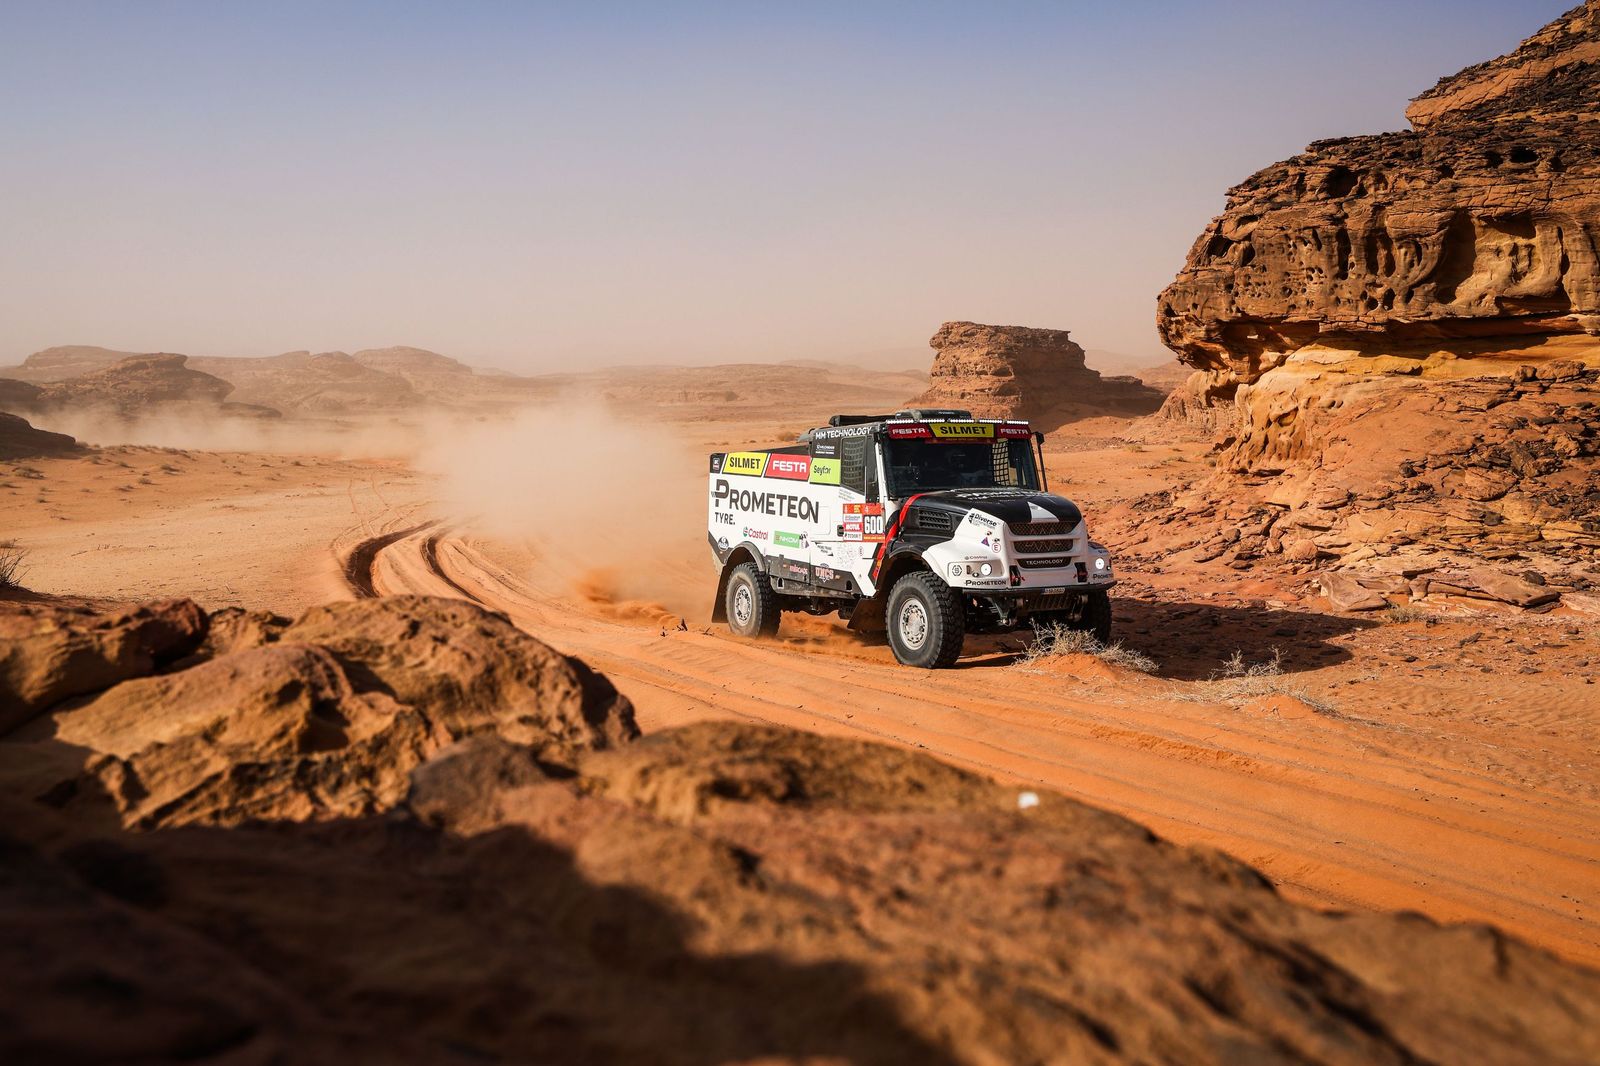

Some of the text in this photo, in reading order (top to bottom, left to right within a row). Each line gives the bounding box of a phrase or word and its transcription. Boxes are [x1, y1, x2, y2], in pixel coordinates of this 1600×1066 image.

[815, 426, 872, 440] MM TECHNOLOGY
[892, 427, 926, 435] FESTA
[940, 426, 987, 435] SILMET
[729, 456, 761, 469] SILMET
[772, 460, 807, 473] FESTA
[864, 515, 884, 534] 600
[974, 513, 997, 527] Diverse
[748, 528, 769, 540] Castrol
[965, 579, 1007, 587] PROMETEON
